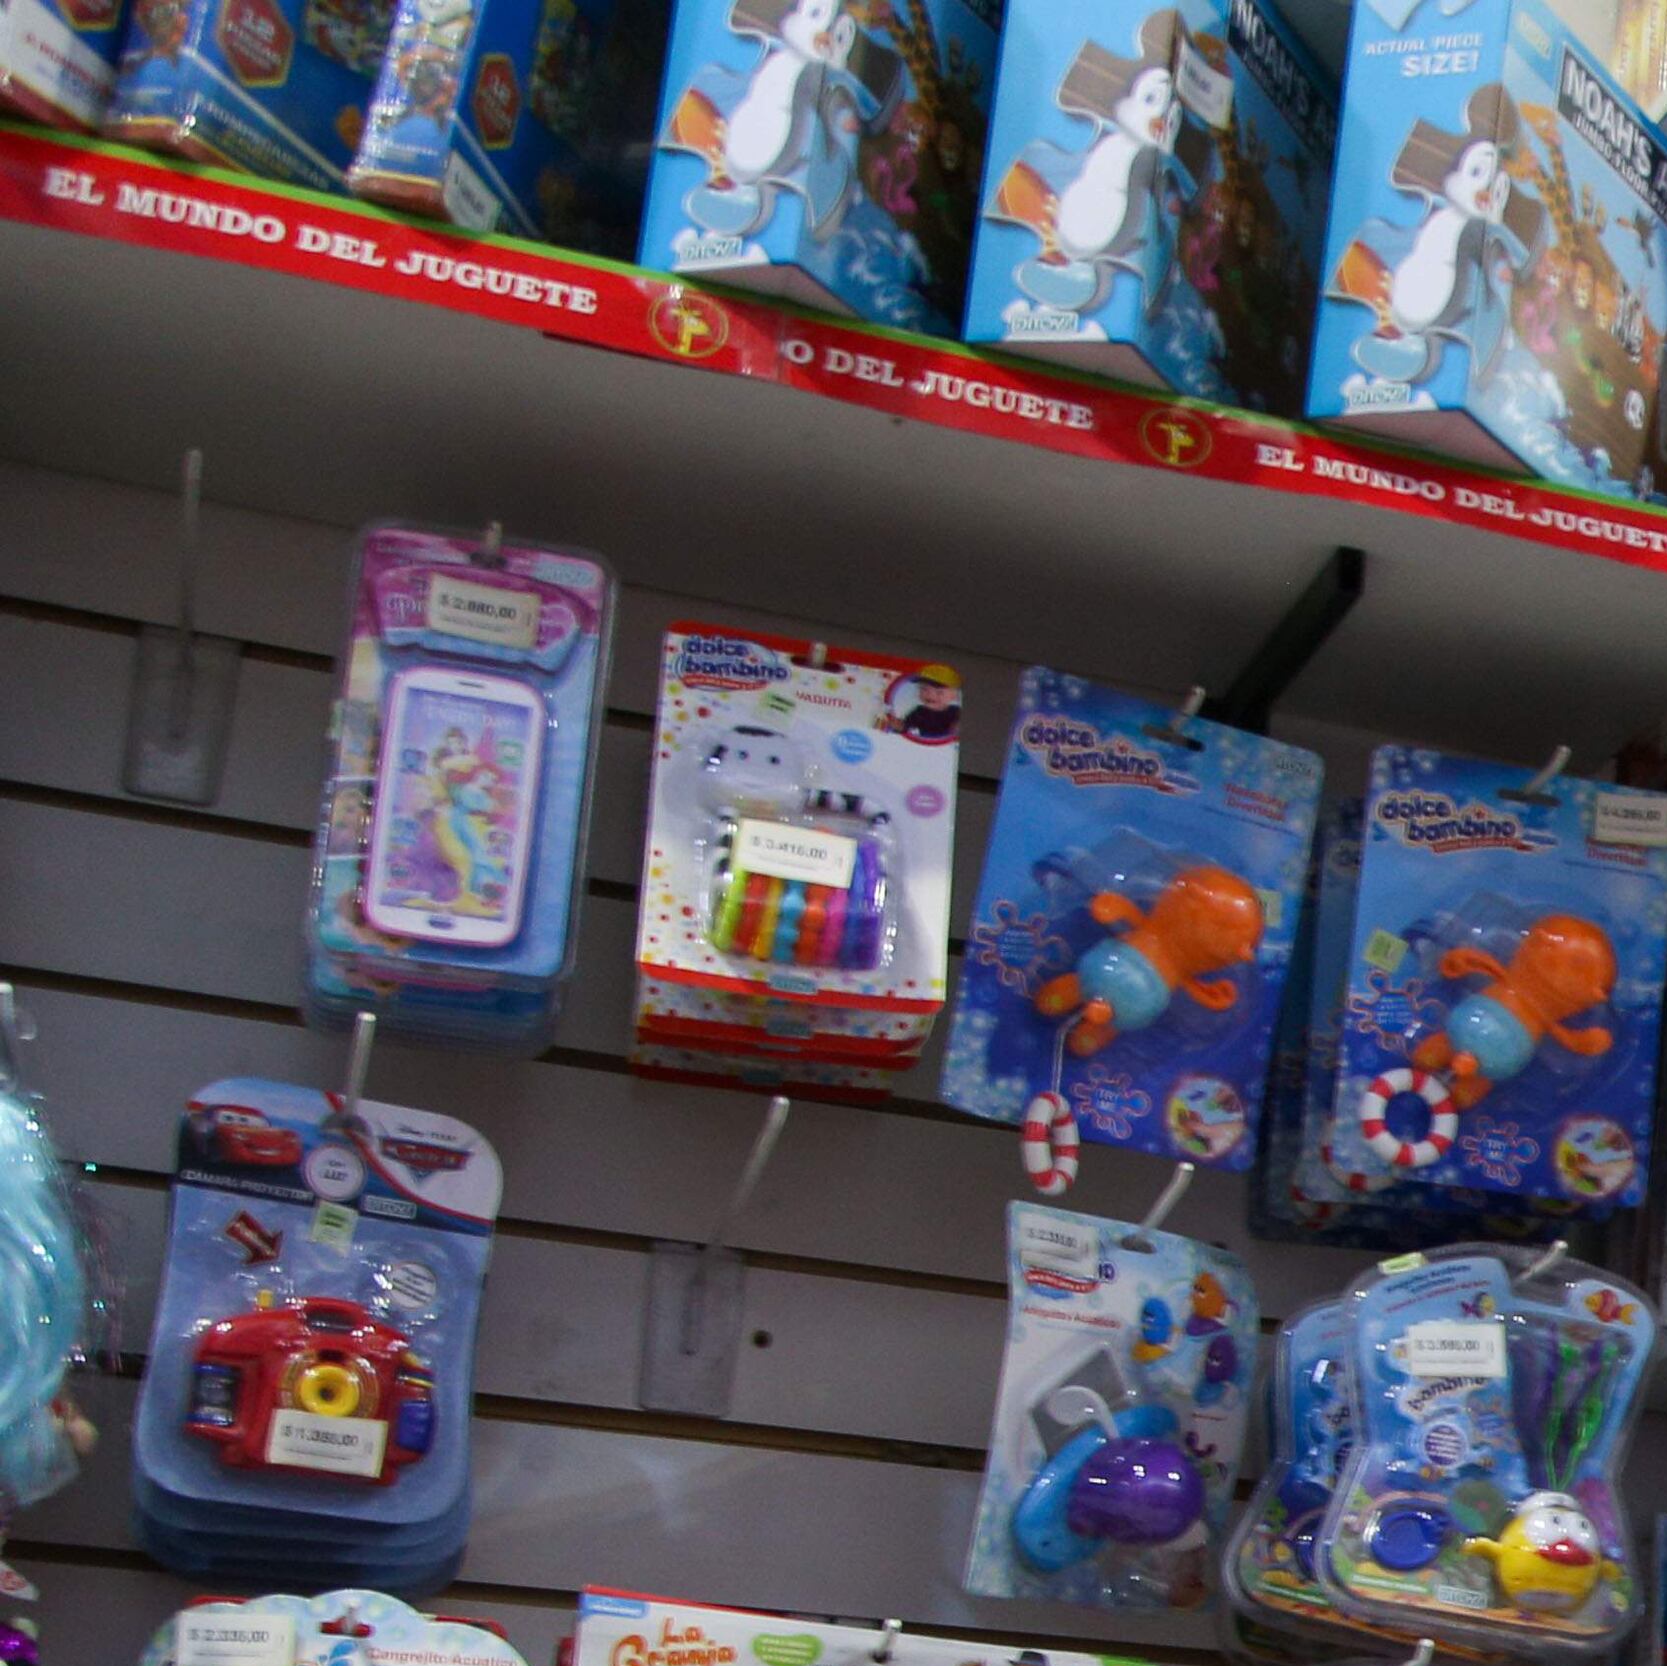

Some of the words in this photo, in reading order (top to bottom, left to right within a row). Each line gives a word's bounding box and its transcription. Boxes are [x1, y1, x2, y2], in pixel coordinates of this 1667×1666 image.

[1562, 55, 1651, 176] NOAH'S
[44, 167, 103, 204] EL
[117, 183, 285, 243] MUNDO
[296, 225, 385, 267] DEL
[395, 252, 597, 314] JUGUETE
[826, 348, 904, 387] DEL
[913, 371, 1095, 430] JUGUETE
[1256, 444, 1304, 470] EL
[1313, 457, 1445, 501] MUNDO
[1456, 485, 1525, 522] DEL
[683, 636, 749, 659] dolce
[681, 656, 789, 681] bambino
[1024, 719, 1093, 750] dolce
[1049, 744, 1158, 778] bambino
[1380, 794, 1449, 824] dolce
[1405, 810, 1517, 844] bambino
[660, 1616, 703, 1646] La
